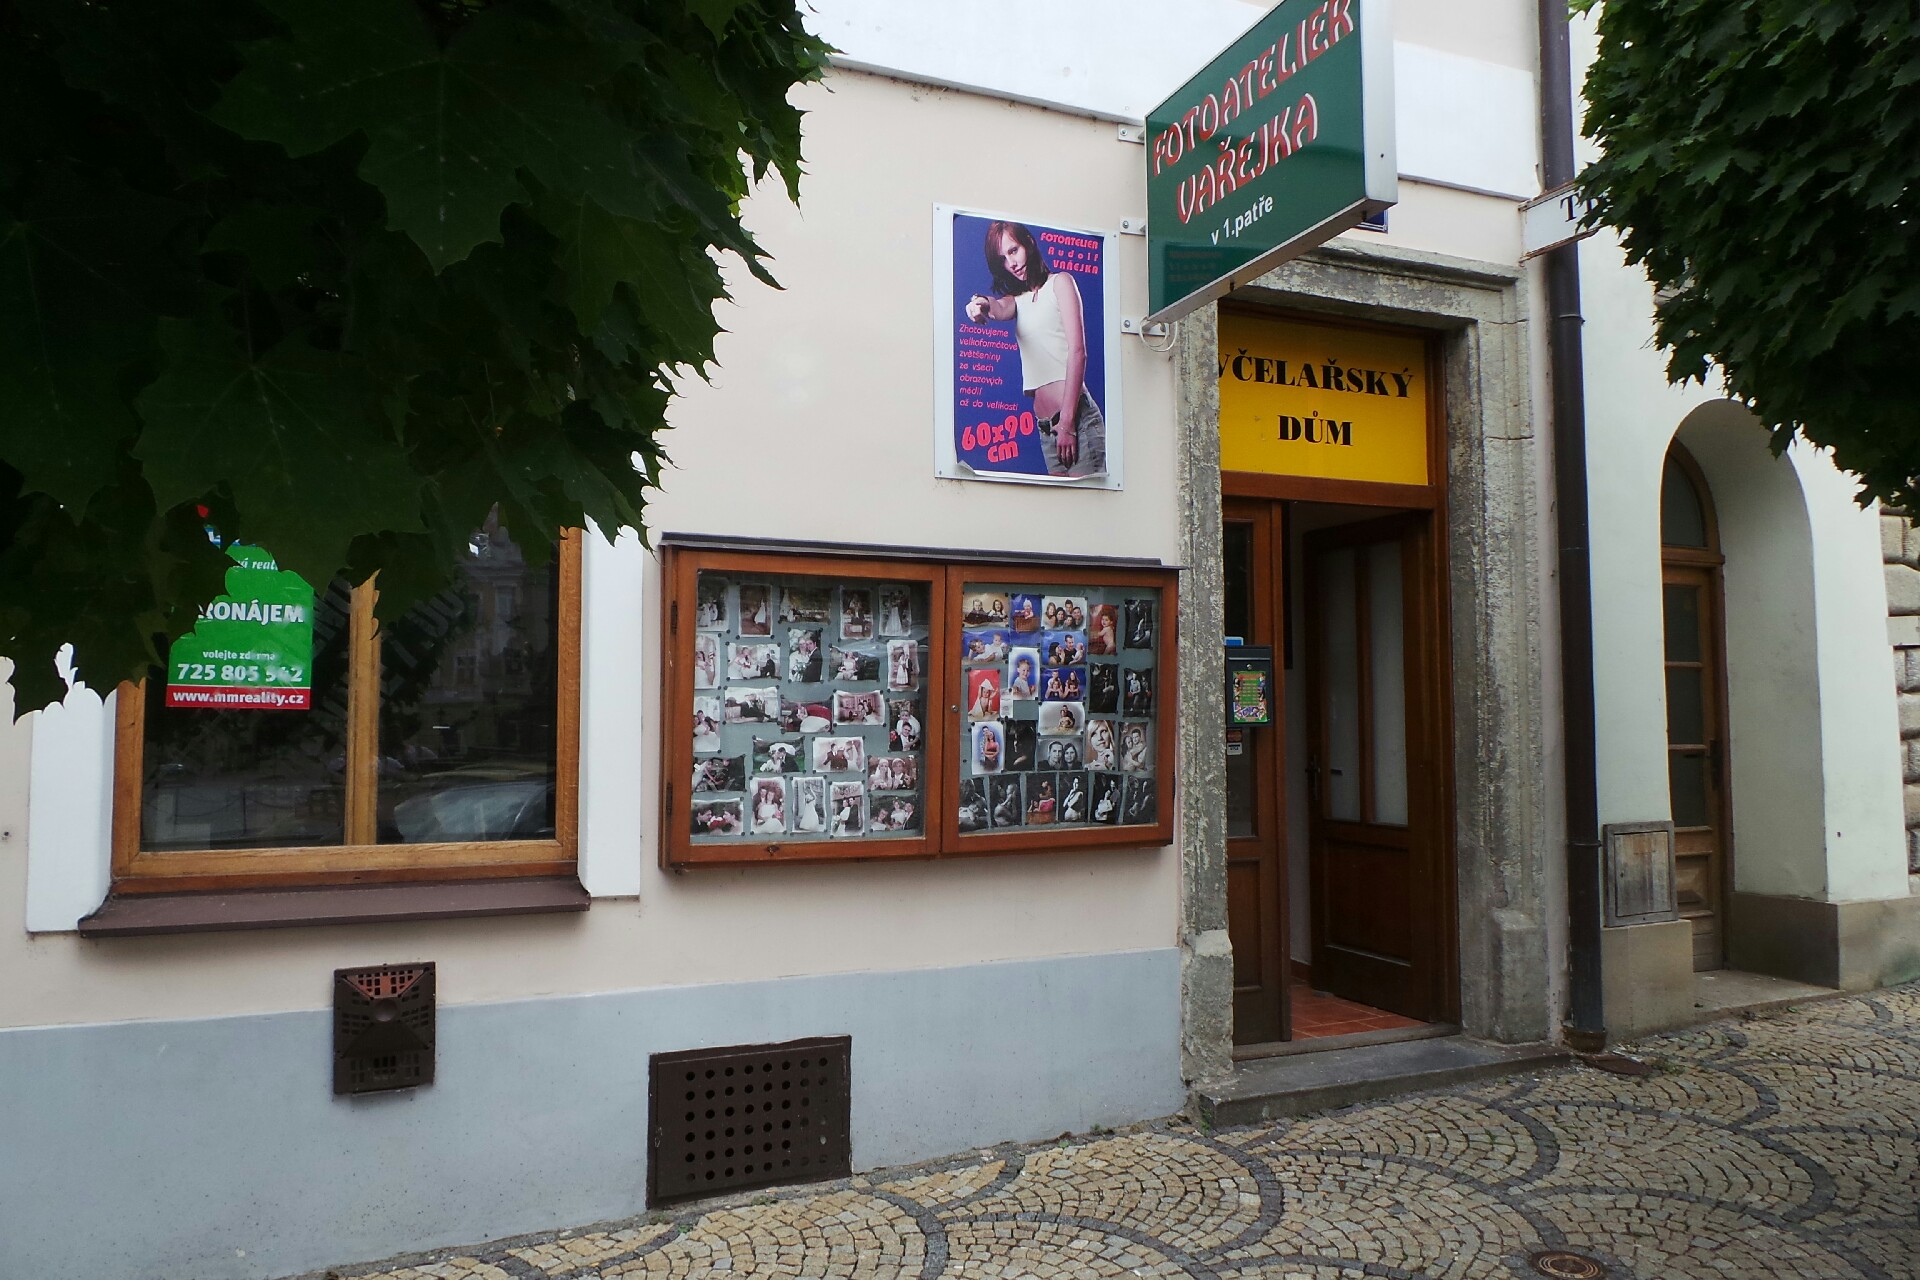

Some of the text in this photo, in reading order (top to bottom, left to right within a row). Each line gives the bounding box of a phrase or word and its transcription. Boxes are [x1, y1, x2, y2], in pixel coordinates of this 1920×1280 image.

[1153, 0, 1354, 177] FOTOATELIER
[1177, 92, 1318, 225] VAŘEJKA
[1211, 194, 1273, 246] v 1.patře
[1041, 232, 1099, 250] FOTOATELIER
[1053, 259, 1099, 275] VAŘEJKA
[959, 323, 1009, 338] Zhotovujeme
[960, 336, 1018, 351] velkoformátové
[959, 350, 1001, 363] zvětšeniny
[959, 362, 994, 373] ze všech
[1218, 347, 1415, 399] VČELAŘSKÝ
[960, 374, 1003, 387] obrazových
[960, 386, 983, 396] médií
[960, 398, 1019, 412] až do velikosti
[961, 411, 1034, 451] 60x90
[1277, 411, 1354, 447] DŮM
[987, 440, 1019, 463] cm
[251, 559, 279, 571] real
[198, 599, 304, 626] RONÁJEM
[203, 650, 276, 662] volejte zdrma
[177, 663, 216, 681] 725
[221, 664, 259, 682] 805
[173, 691, 304, 706] www.mmreality.cz
